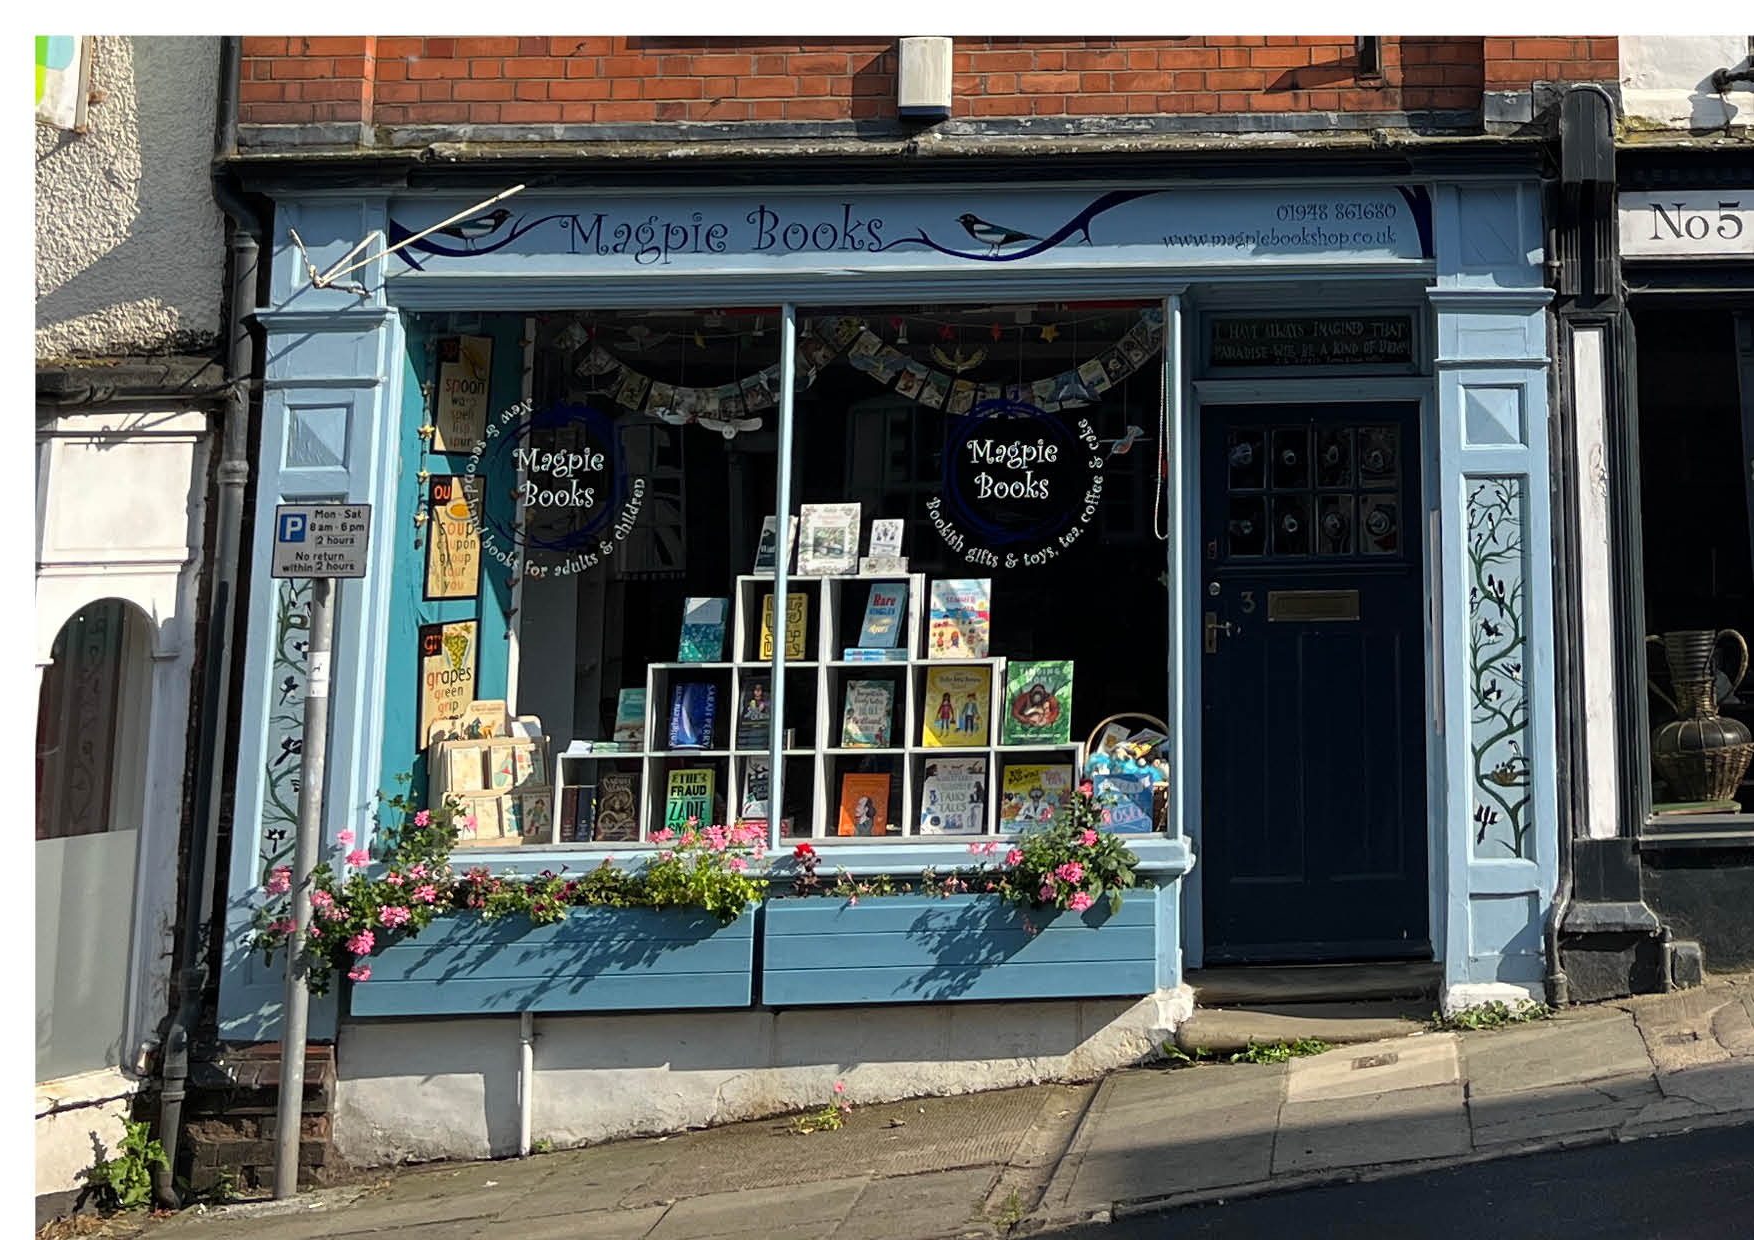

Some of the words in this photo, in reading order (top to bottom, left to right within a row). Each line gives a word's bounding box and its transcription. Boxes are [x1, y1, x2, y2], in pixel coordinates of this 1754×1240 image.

[1277, 203, 1328, 220] 01948
[1334, 202, 1397, 220] 861680
[1649, 201, 1709, 241] No
[1717, 200, 1744, 240] 5
[559, 210, 729, 264] Magpie
[748, 203, 886, 254] Books
[501, 398, 534, 424] New
[1077, 418, 1099, 451] cake
[512, 447, 605, 478] Magpie
[966, 438, 1058, 470] Magpie
[1088, 455, 1103, 469] &
[519, 479, 595, 508] Books
[974, 470, 1049, 500] Books
[614, 478, 645, 541] children
[1080, 475, 1104, 523] coffee
[315, 510, 336, 519] Mon
[344, 510, 362, 519] Sat
[926, 496, 964, 553] Bookish
[286, 517, 302, 540] P
[317, 536, 324, 545] 2
[327, 536, 354, 545] hours
[482, 535, 520, 569] books
[599, 540, 613, 555] &
[282, 563, 313, 572] within
[316, 562, 323, 570] 2
[327, 561, 354, 570] hours
[295, 552, 309, 561] No
[313, 552, 344, 561] return
[554, 553, 599, 577] adults
[965, 548, 999, 568] gifts
[1005, 552, 1019, 568] &
[525, 561, 546, 577] for
[427, 666, 472, 690] grapes
[434, 685, 464, 700] green
[438, 700, 459, 717] grip
[670, 785, 707, 796] FRAUD
[669, 800, 706, 821] ZADIE
